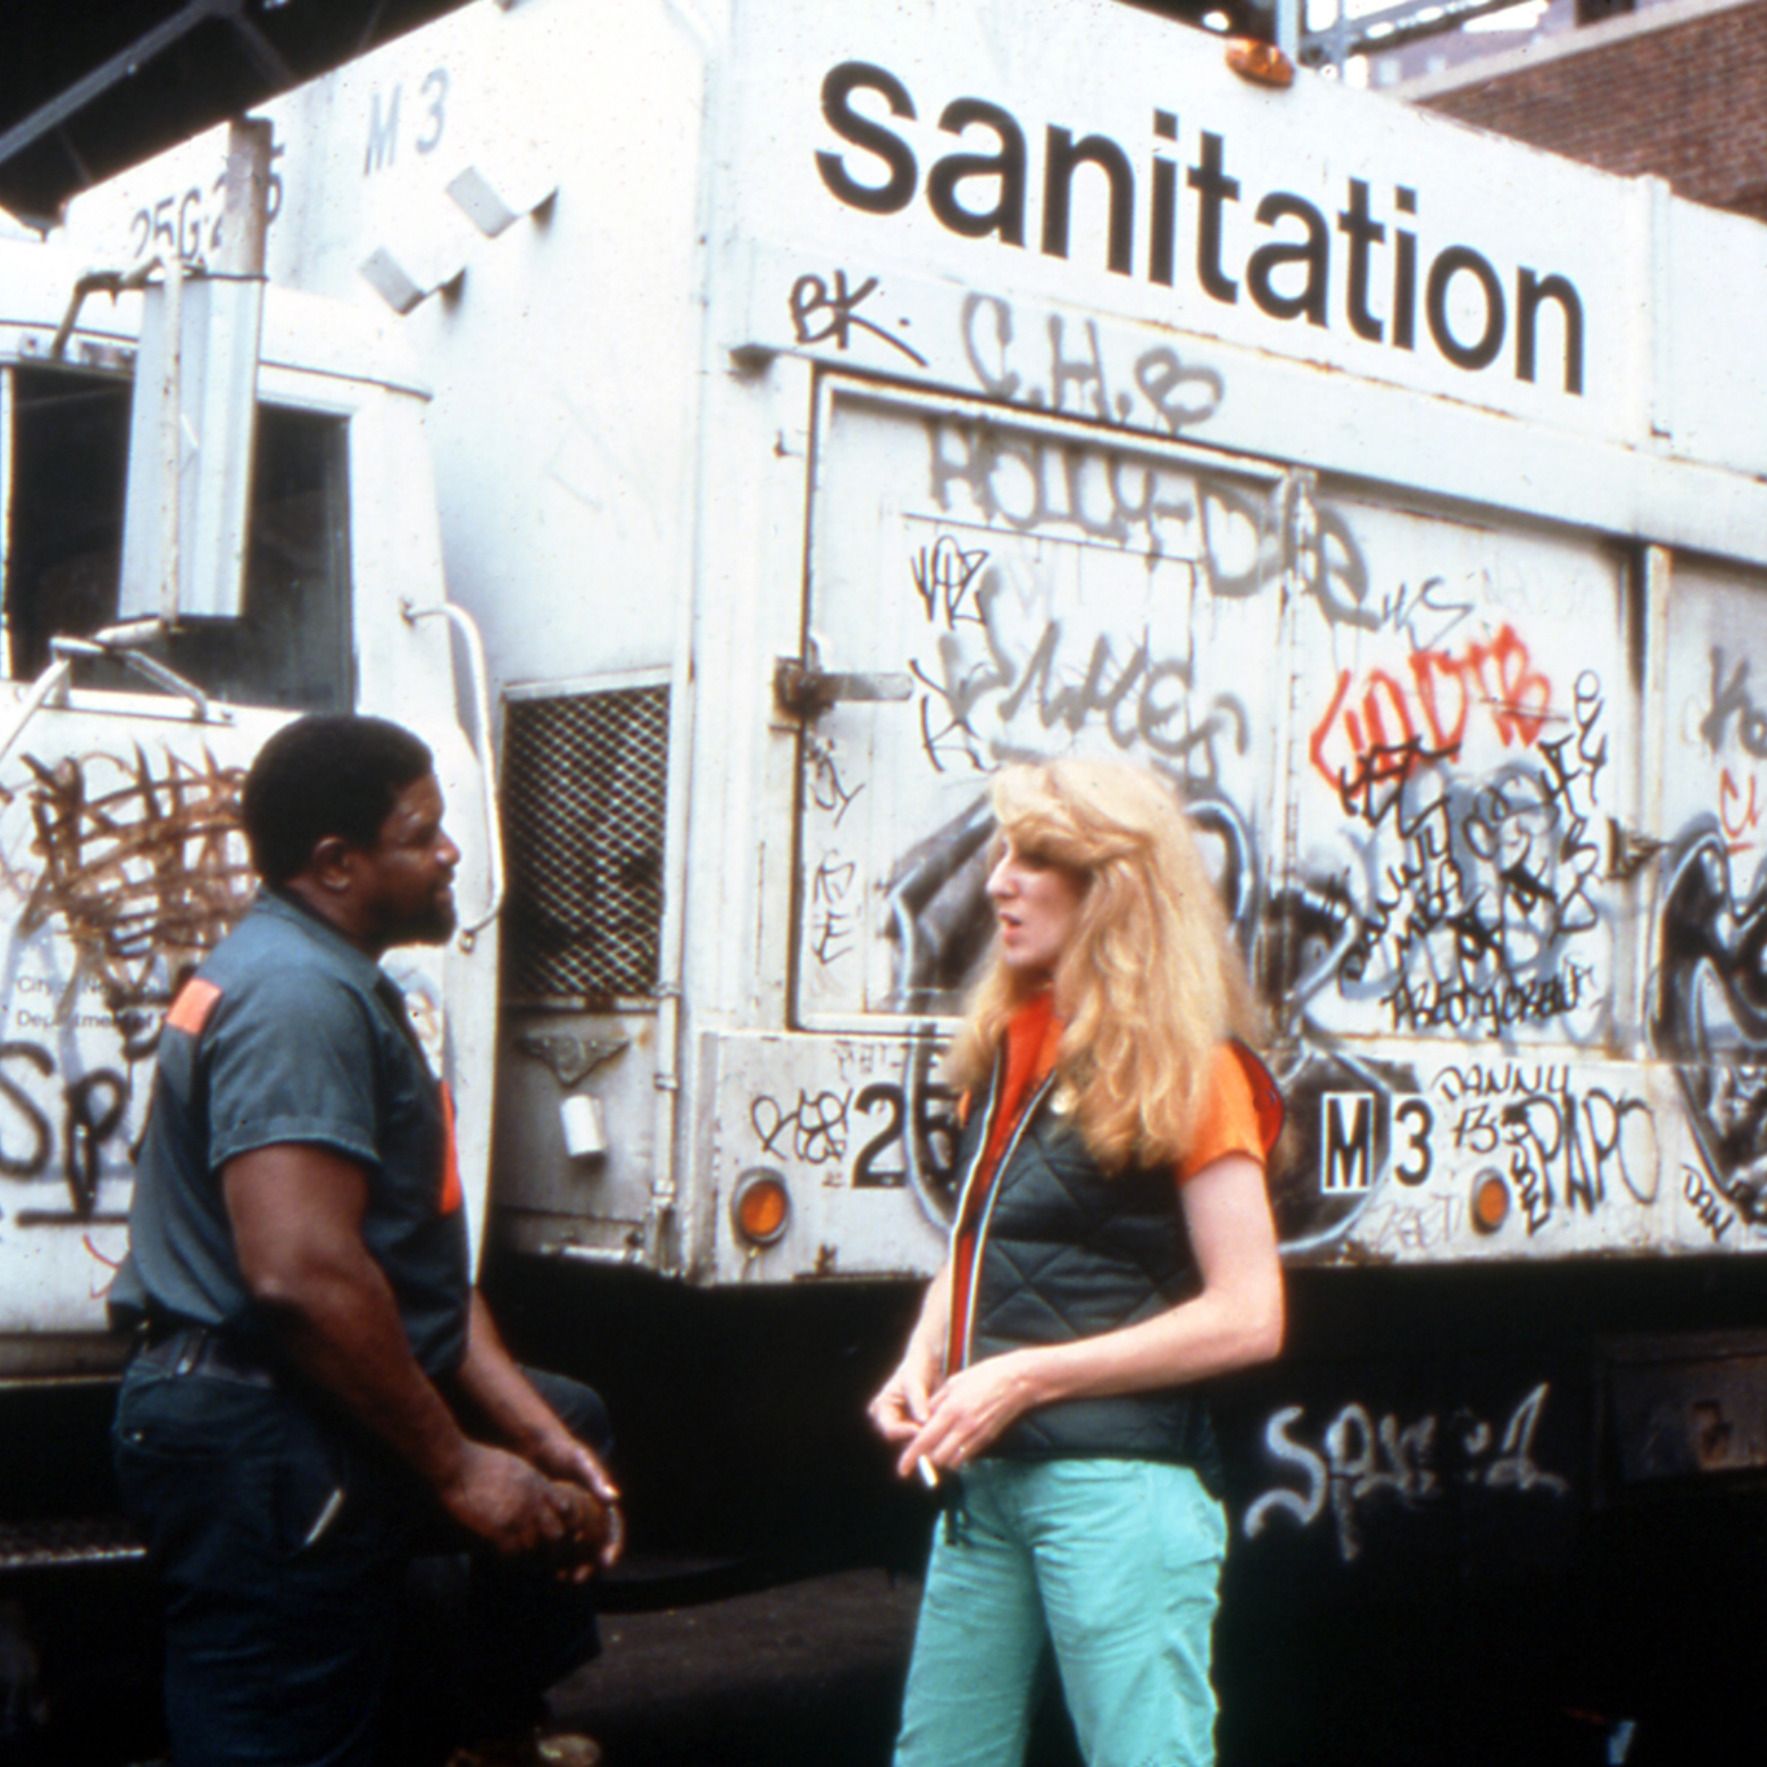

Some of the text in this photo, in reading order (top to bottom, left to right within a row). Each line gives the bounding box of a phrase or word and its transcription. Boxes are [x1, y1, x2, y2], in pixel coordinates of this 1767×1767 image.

[416, 66, 450, 155] 3
[814, 60, 1585, 397] sanitation
[1324, 1095, 1432, 1191] M 3
